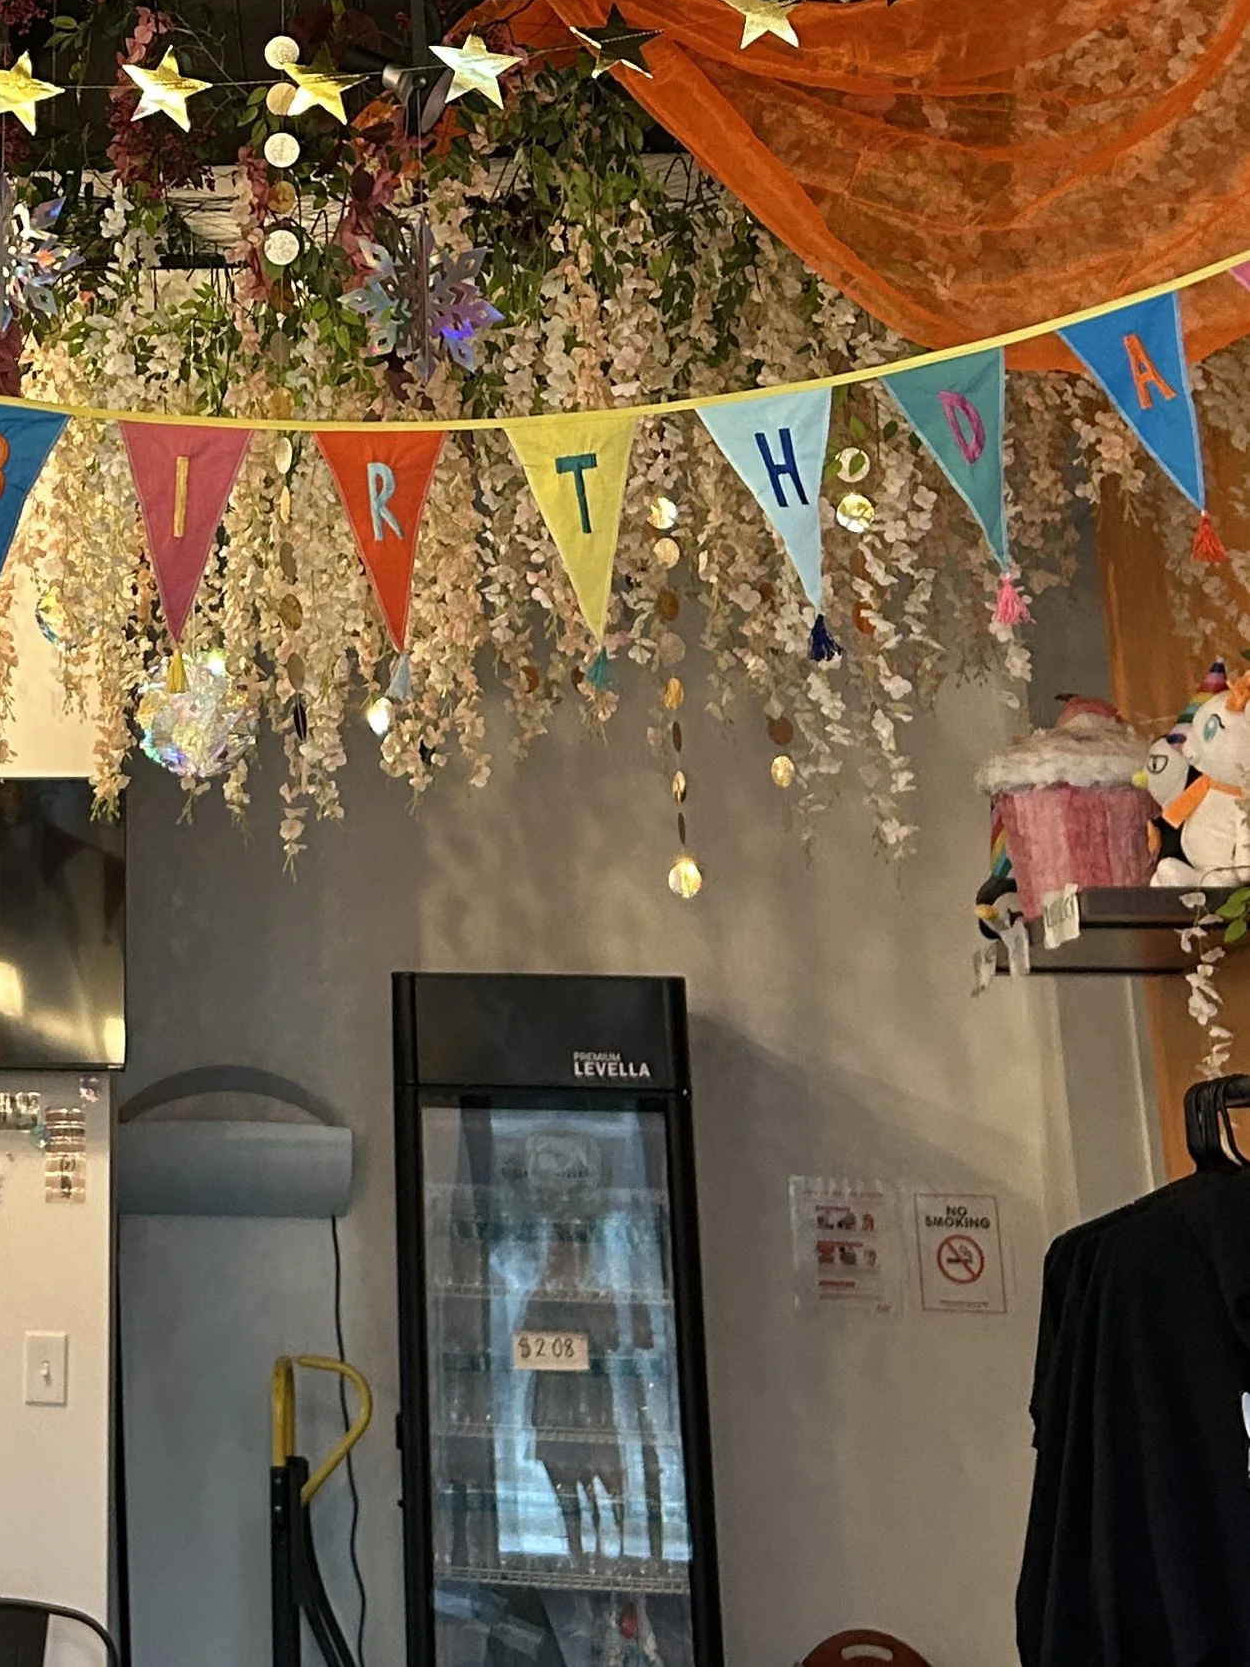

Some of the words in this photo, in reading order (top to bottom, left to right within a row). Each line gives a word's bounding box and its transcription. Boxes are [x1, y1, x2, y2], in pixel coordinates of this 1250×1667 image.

[573, 1062, 651, 1077] LEVELLA
[946, 1205, 968, 1216] NO
[925, 1216, 991, 1230] SMOKING
